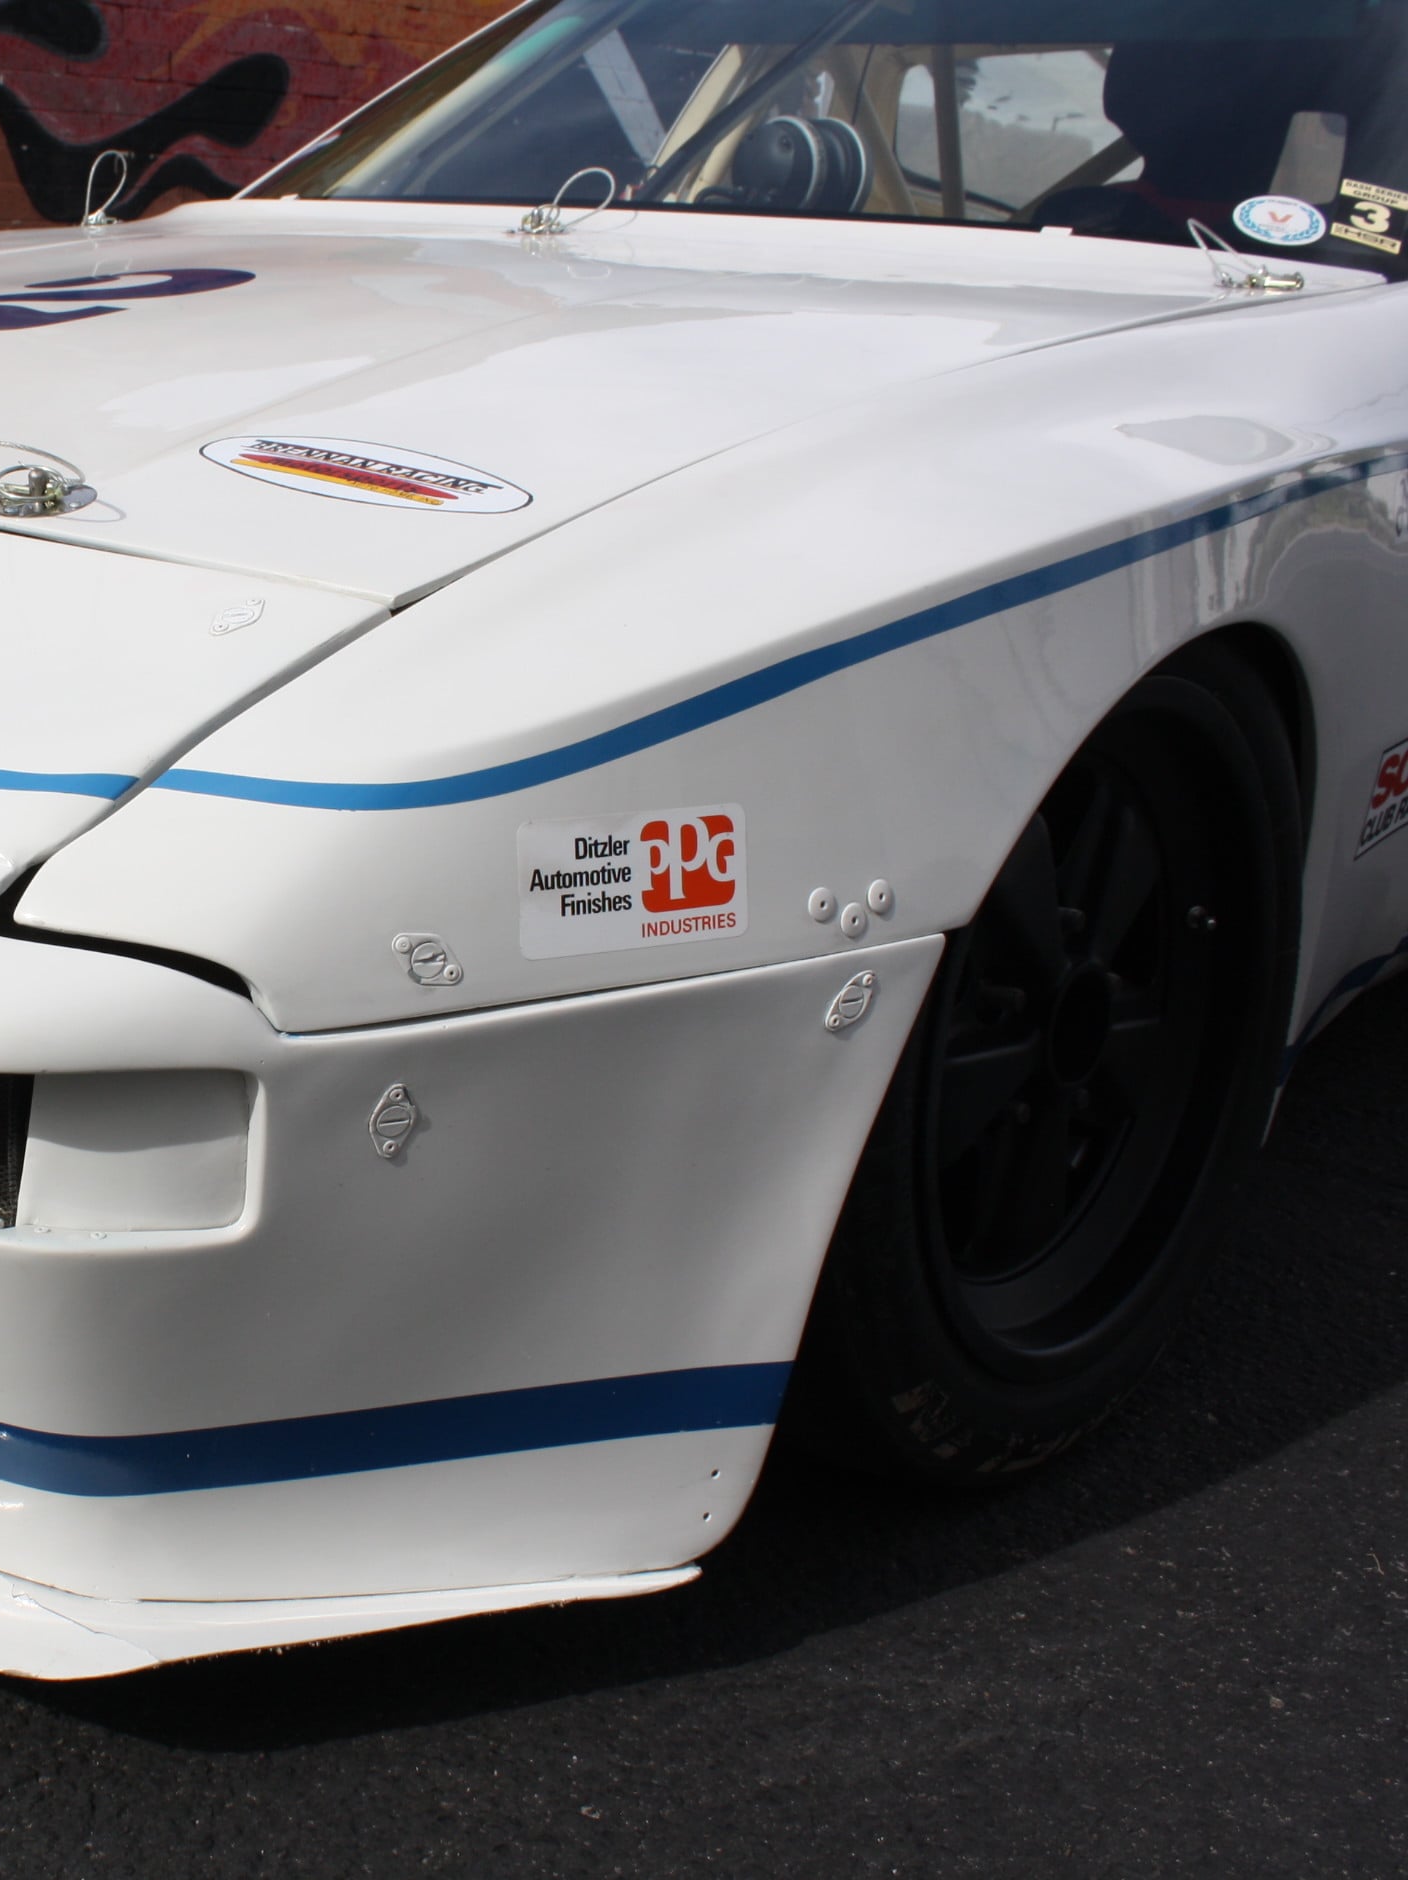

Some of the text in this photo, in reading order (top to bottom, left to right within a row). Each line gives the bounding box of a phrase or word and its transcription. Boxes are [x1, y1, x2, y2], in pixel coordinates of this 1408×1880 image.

[1353, 190, 1399, 204] GROUP
[1350, 201, 1391, 233] 3
[379, 463, 491, 495] RACING
[575, 835, 630, 860] Ditzler
[530, 862, 632, 892] Automotive
[560, 891, 632, 917] Finishes
[641, 912, 737, 938] INDUSTRIES
